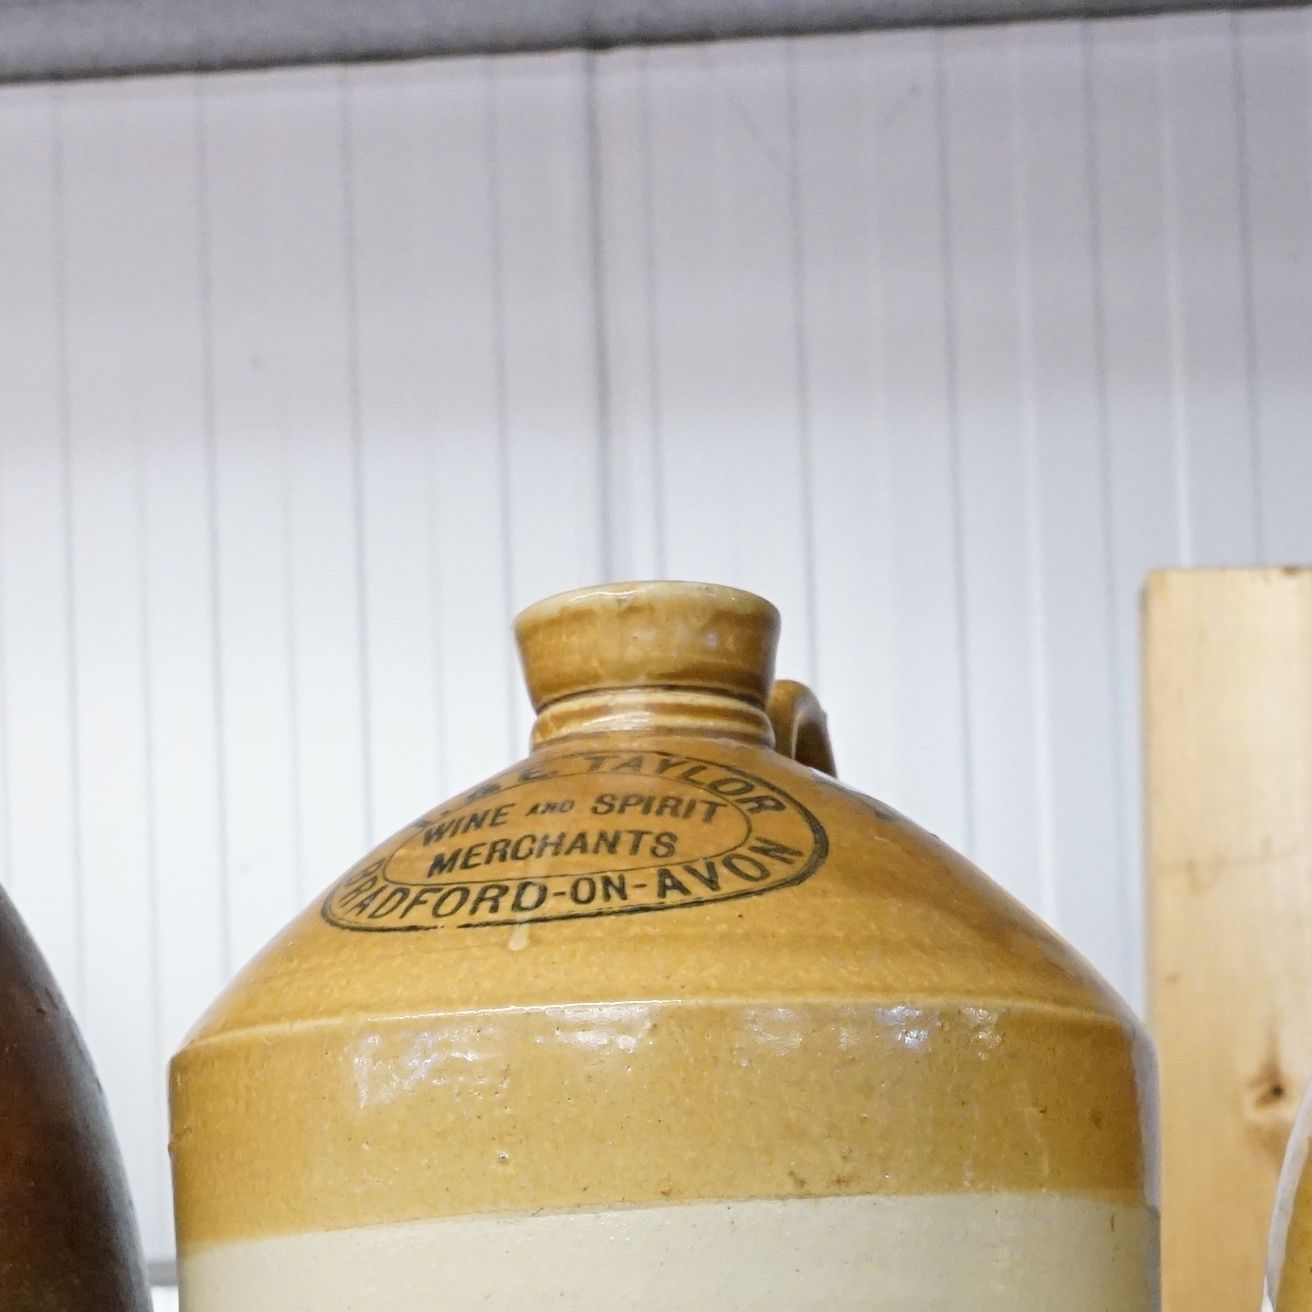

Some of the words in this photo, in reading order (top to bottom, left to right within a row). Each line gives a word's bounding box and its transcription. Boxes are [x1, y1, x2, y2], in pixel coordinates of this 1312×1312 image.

[583, 755, 787, 815] TAYLOR
[422, 802, 517, 847] WINE
[524, 799, 576, 817] AND
[591, 793, 728, 824] SPIRIT
[339, 836, 804, 920] BRADFORD-ON-AVON
[425, 829, 678, 878] MERCHANTS
